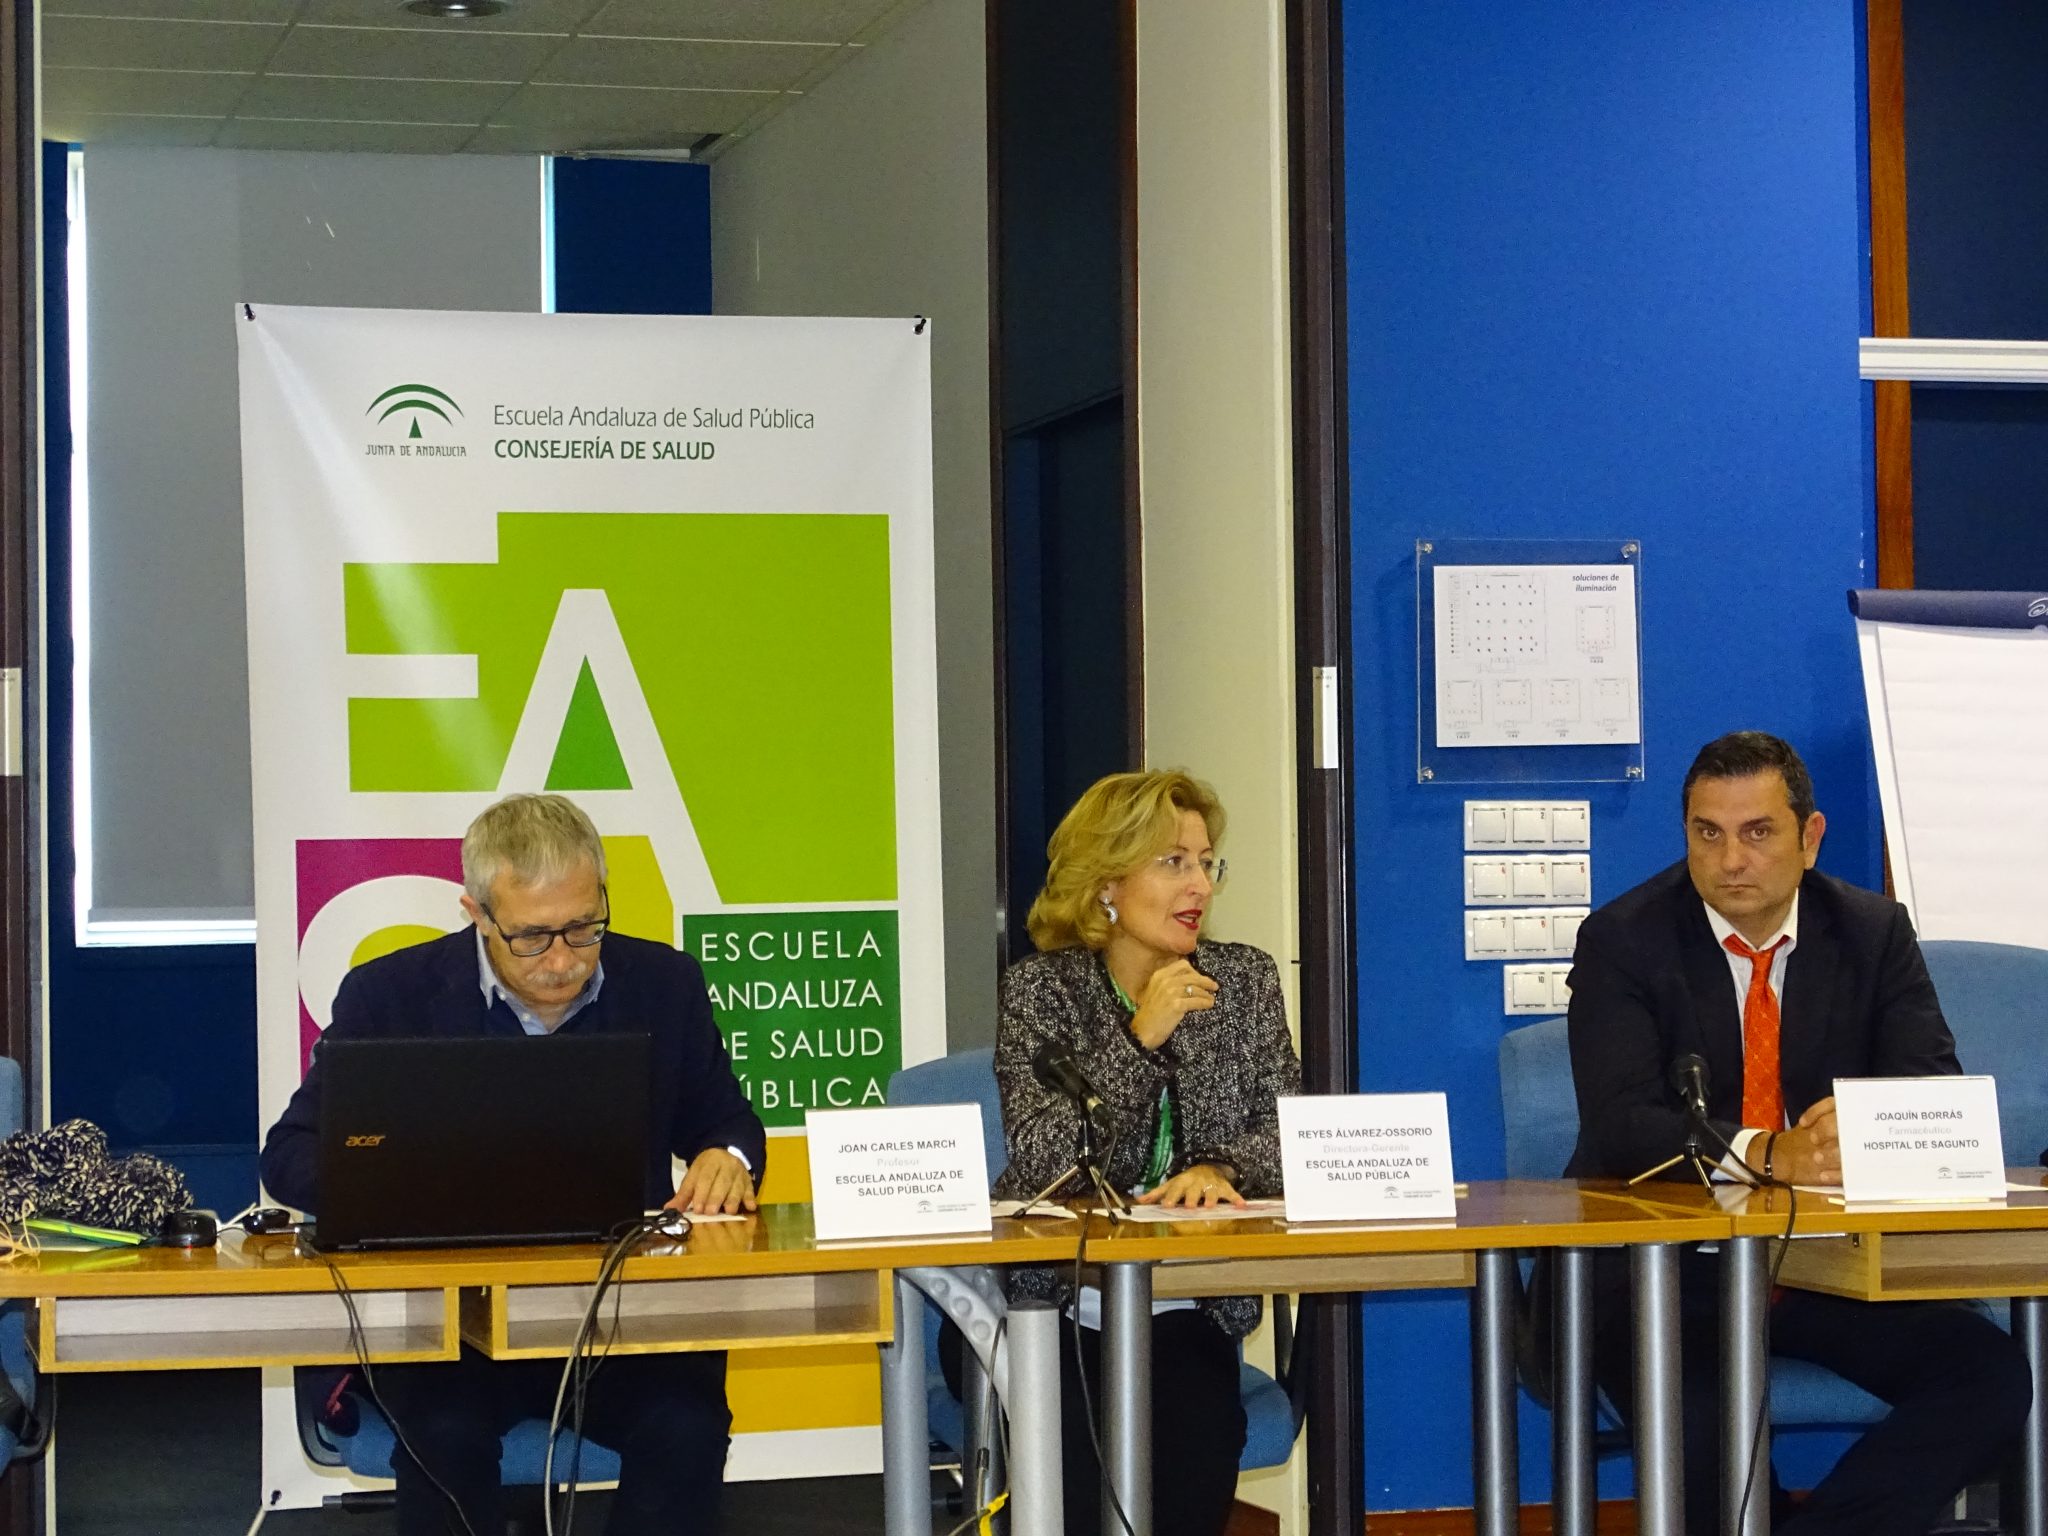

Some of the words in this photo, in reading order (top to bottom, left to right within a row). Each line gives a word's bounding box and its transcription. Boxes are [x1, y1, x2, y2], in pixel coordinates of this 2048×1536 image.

[494, 405, 563, 426] Escuela
[569, 406, 657, 427] Andaluza
[663, 407, 687, 428] de
[693, 407, 742, 428] Salud
[750, 407, 814, 429] Pública
[365, 445, 395, 456] JUNTA
[400, 445, 411, 456] DE
[494, 436, 614, 459] CONSEJERÍA
[621, 441, 646, 459] DE
[652, 441, 715, 460] SALUD
[1572, 573, 1609, 582] soluciones
[1610, 573, 1620, 581] de
[1575, 584, 1617, 592] iluminación
[701, 929, 882, 962] ESCUELA
[707, 979, 883, 1011] ANDALUZA
[722, 1031, 748, 1060] E
[770, 1028, 883, 1059] SALUD
[1874, 1110, 1918, 1121] JOAQUÍN
[1921, 1109, 1963, 1120] BORRÁS
[1298, 1130, 1333, 1139] REYES
[1336, 1127, 1433, 1138] ÁLVAREZ-OSSORIO
[345, 1135, 386, 1147] acer
[838, 1144, 867, 1154] JOAN
[870, 1141, 914, 1152] CARLES
[917, 1139, 956, 1150] MARCH
[1863, 1141, 1912, 1150] HOSPITAL
[1915, 1140, 1928, 1149] DE
[1931, 1139, 1979, 1149] SAGUNTO
[1306, 1159, 1355, 1169] ESCUELA
[1357, 1158, 1412, 1168] ANDALUZA
[1415, 1157, 1430, 1167] DE
[835, 1174, 886, 1185] ESCUELA
[888, 1171, 946, 1182] ANDALUZA
[949, 1170, 964, 1179] DE
[1327, 1172, 1362, 1181] SALUD
[1365, 1169, 1410, 1180] PÚBLICA
[858, 1186, 894, 1197] SALUD
[897, 1183, 944, 1195] PÚBLICA
